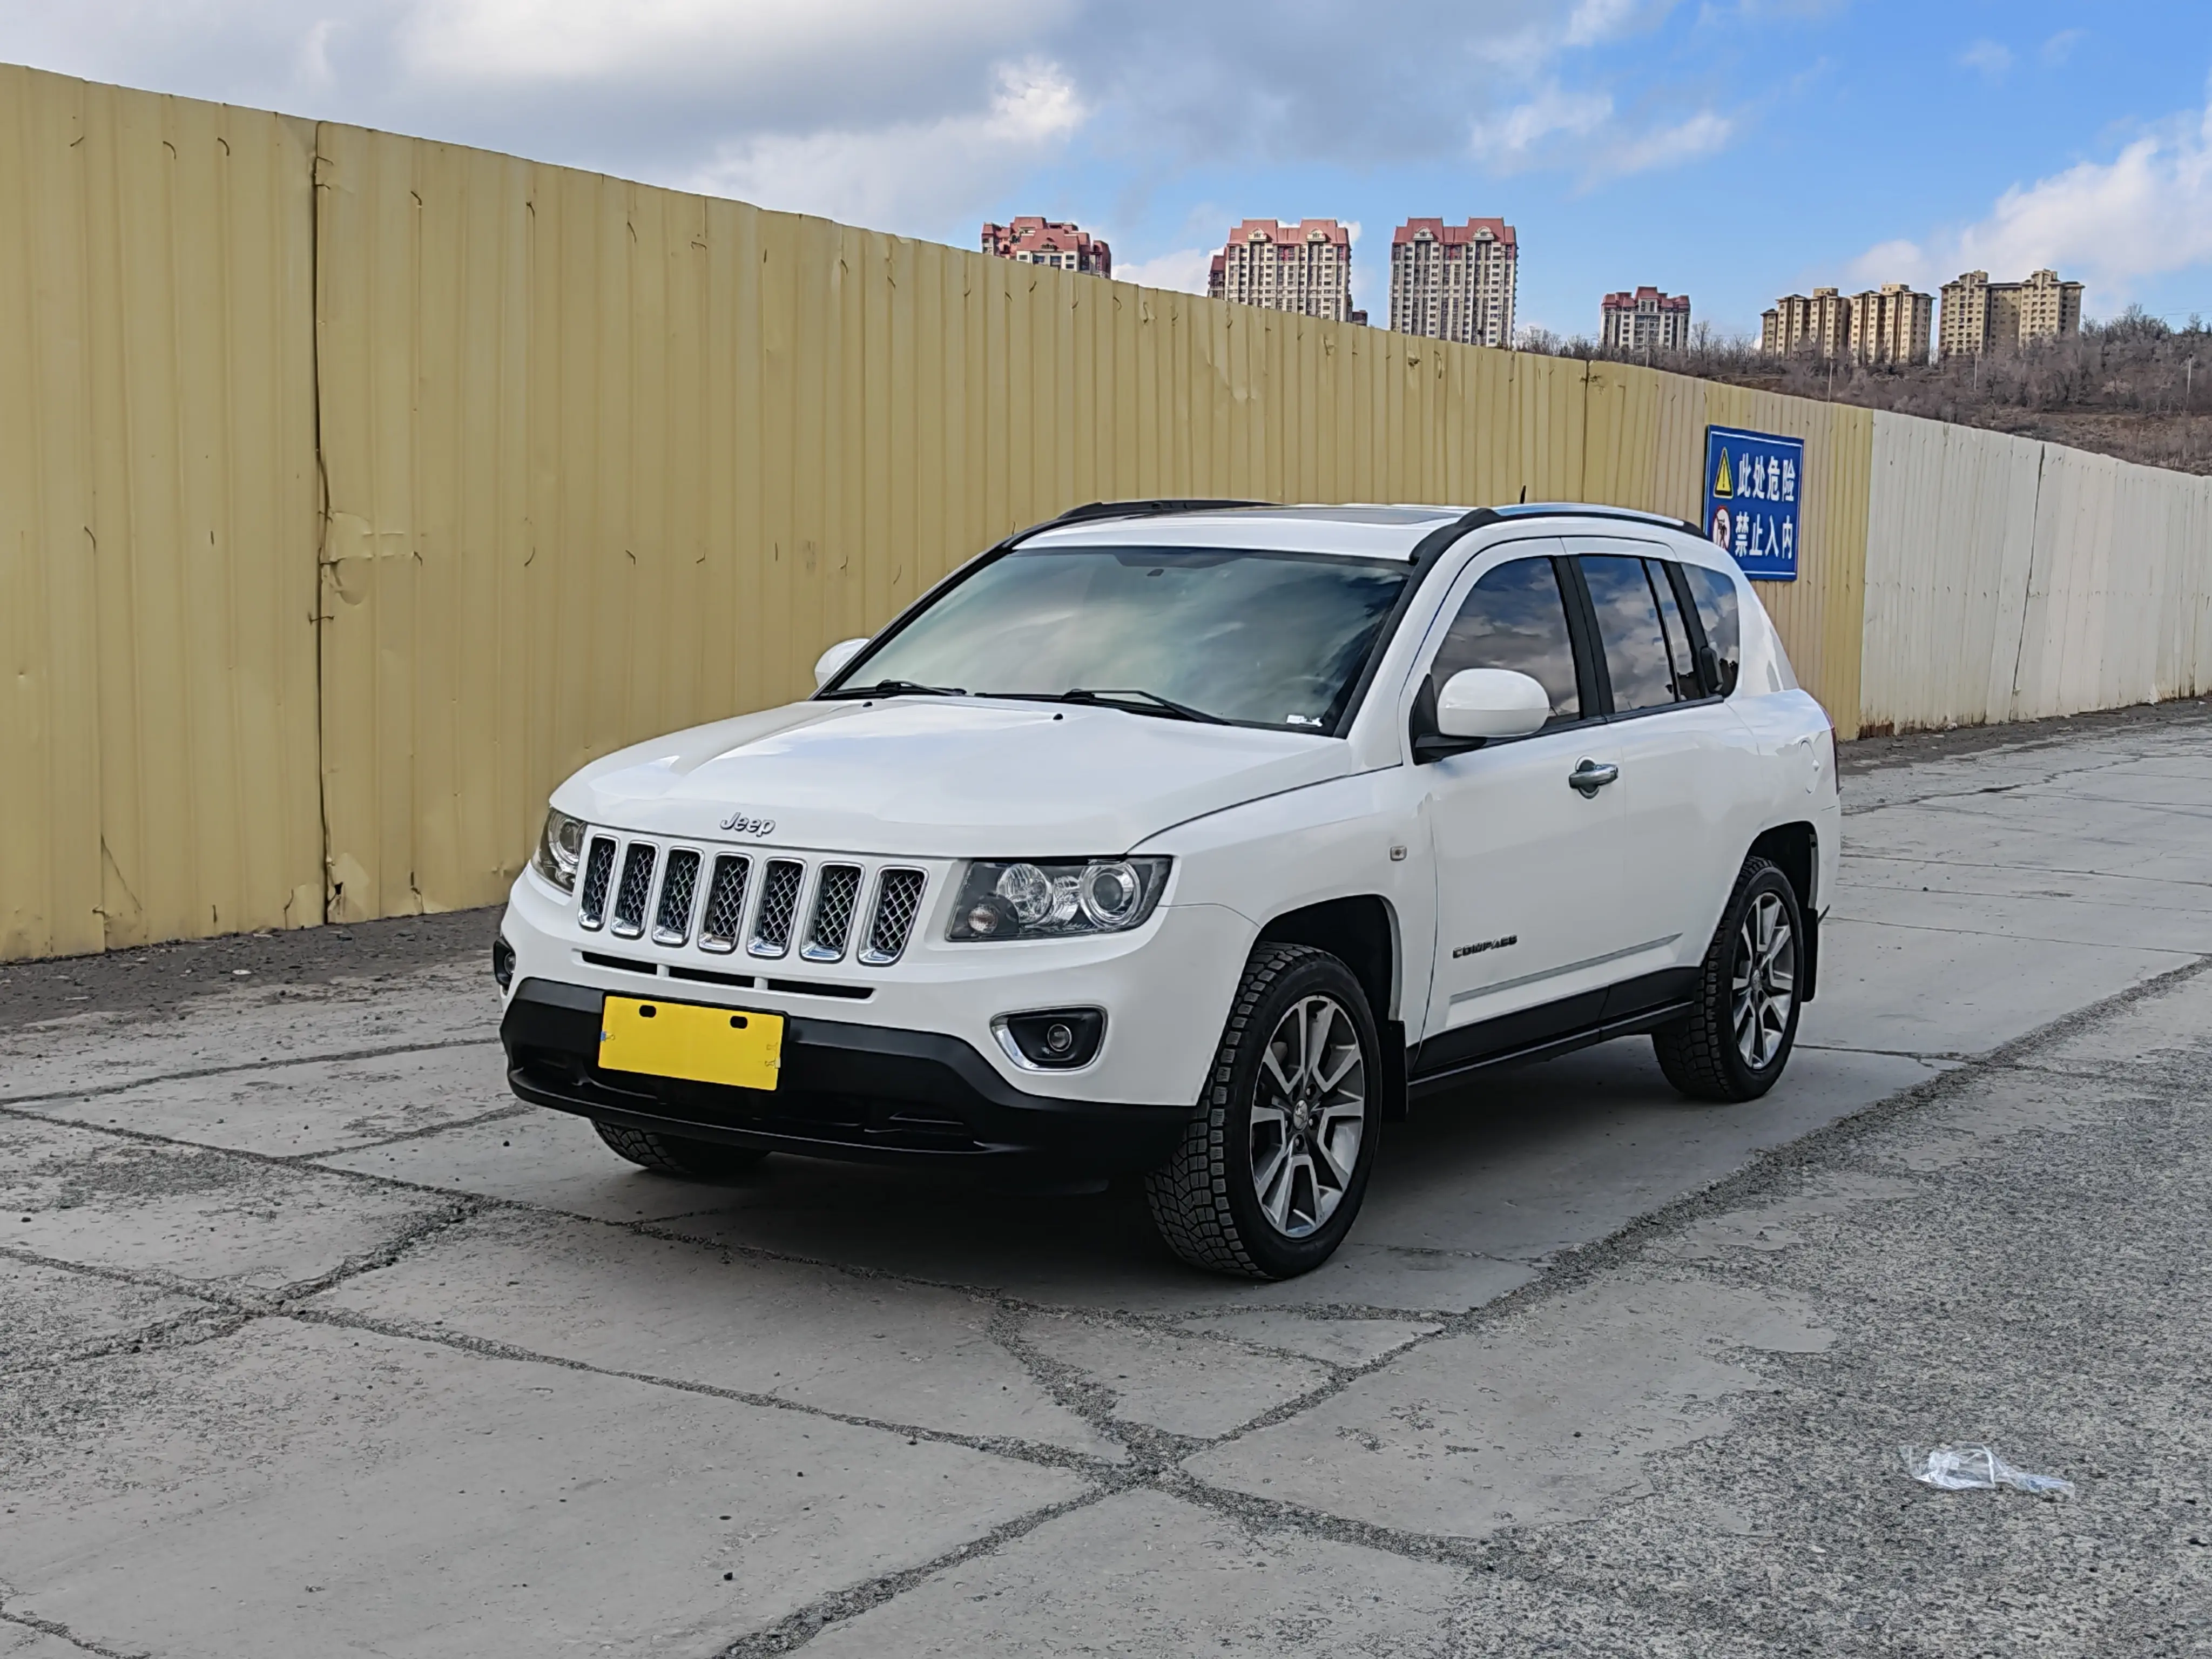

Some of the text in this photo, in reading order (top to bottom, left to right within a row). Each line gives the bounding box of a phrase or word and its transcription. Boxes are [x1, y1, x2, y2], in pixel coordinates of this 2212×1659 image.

[1737, 453, 1796, 502] 此处危险
[1735, 511, 1793, 559] 禁止入内
[720, 811, 776, 838] Jeep
